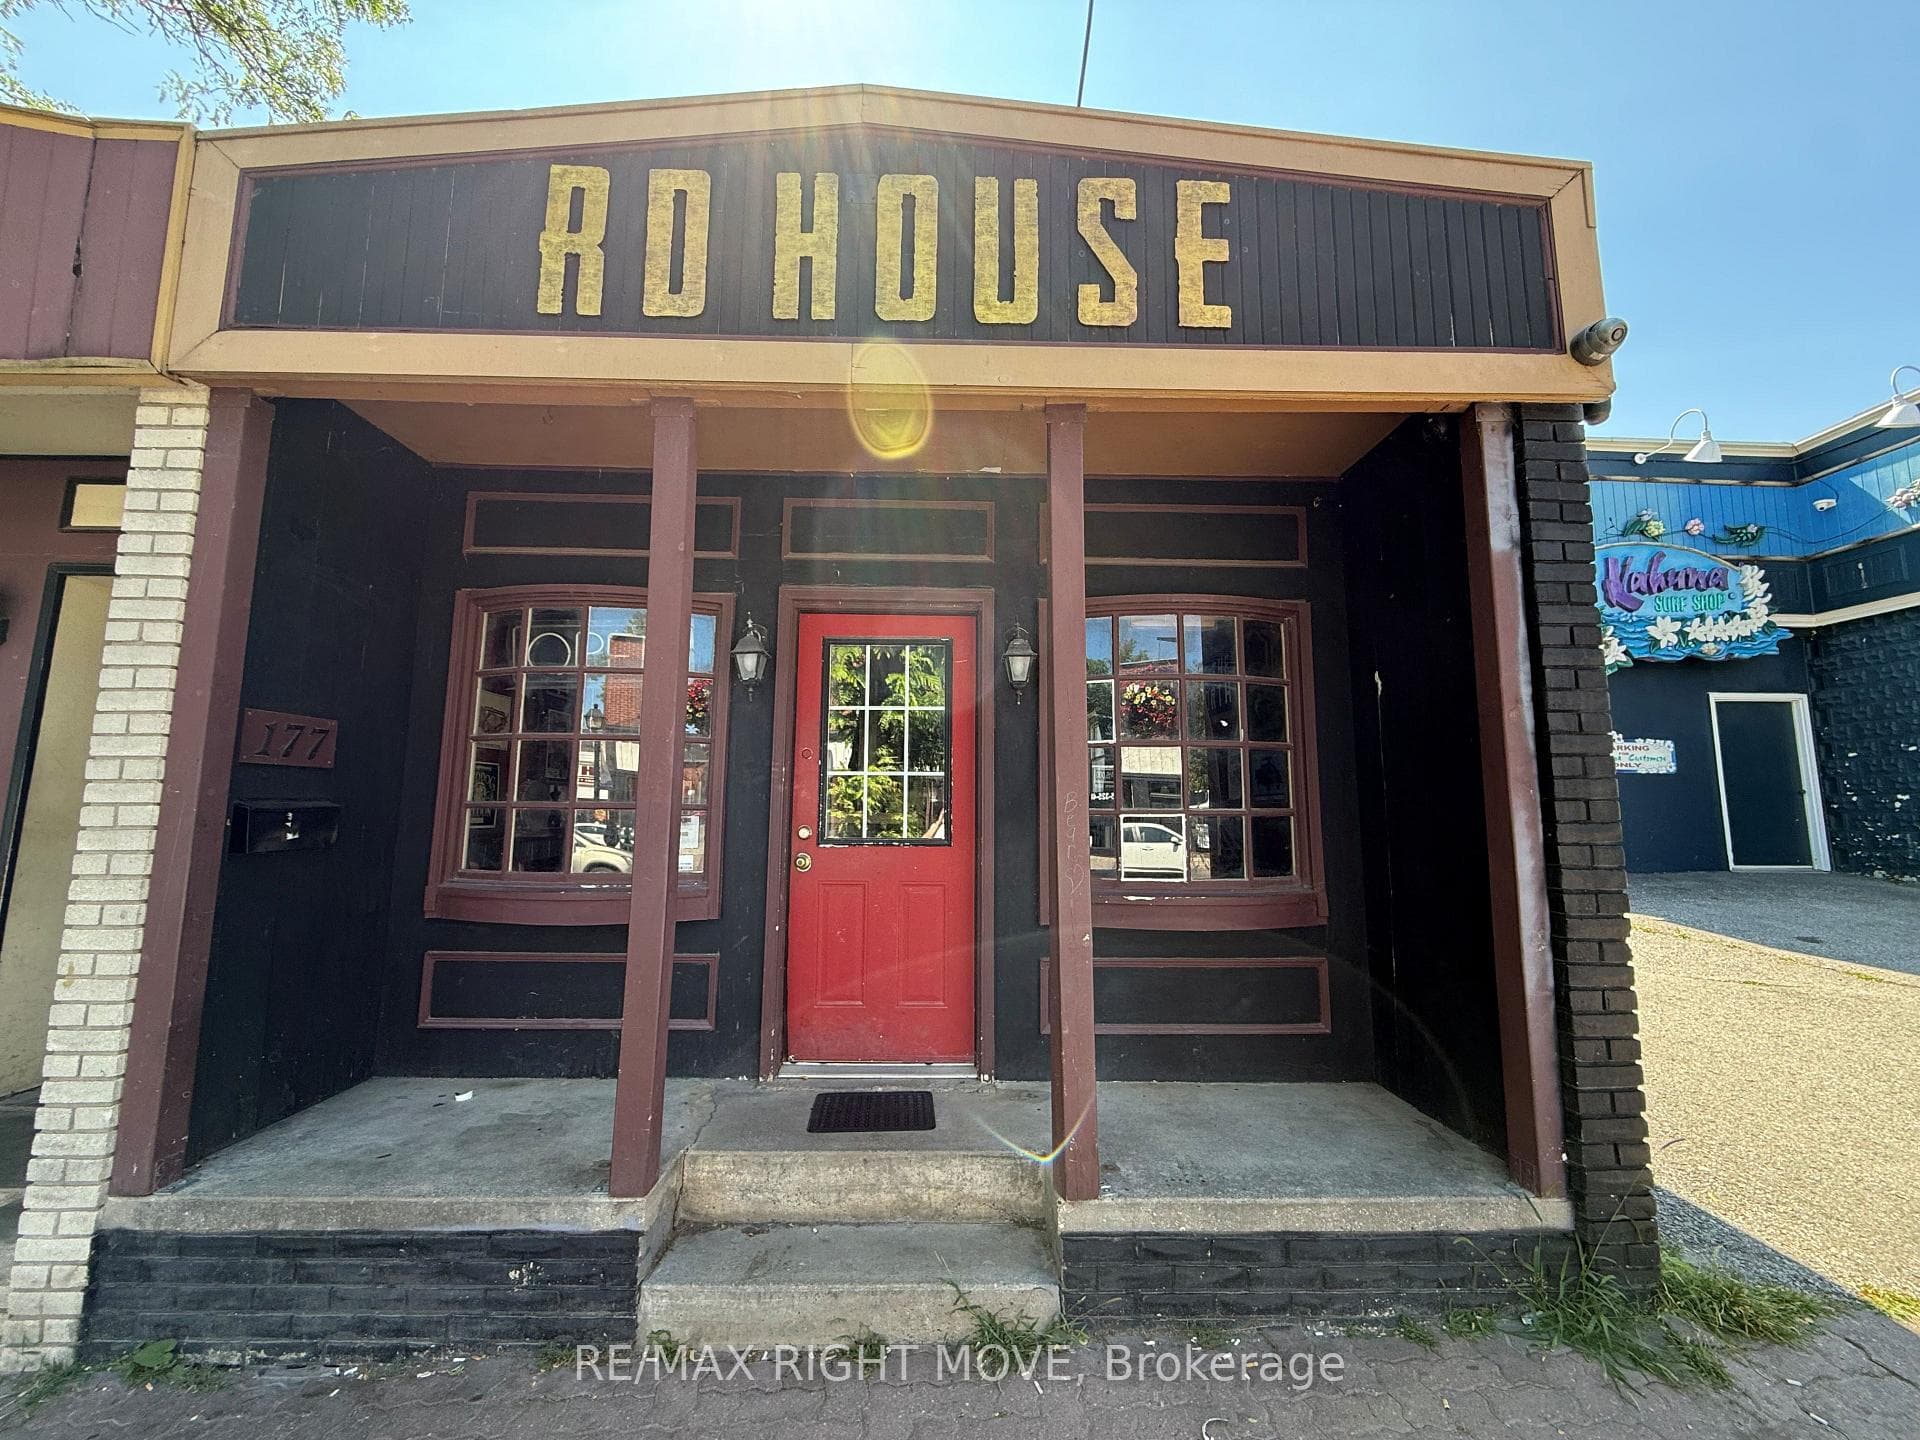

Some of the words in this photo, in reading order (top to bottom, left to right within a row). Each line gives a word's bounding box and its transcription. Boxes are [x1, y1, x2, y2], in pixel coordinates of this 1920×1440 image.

[1601, 551, 1729, 612] Kahuna
[1692, 592, 1725, 612] SHOP
[254, 722, 330, 760] 177
